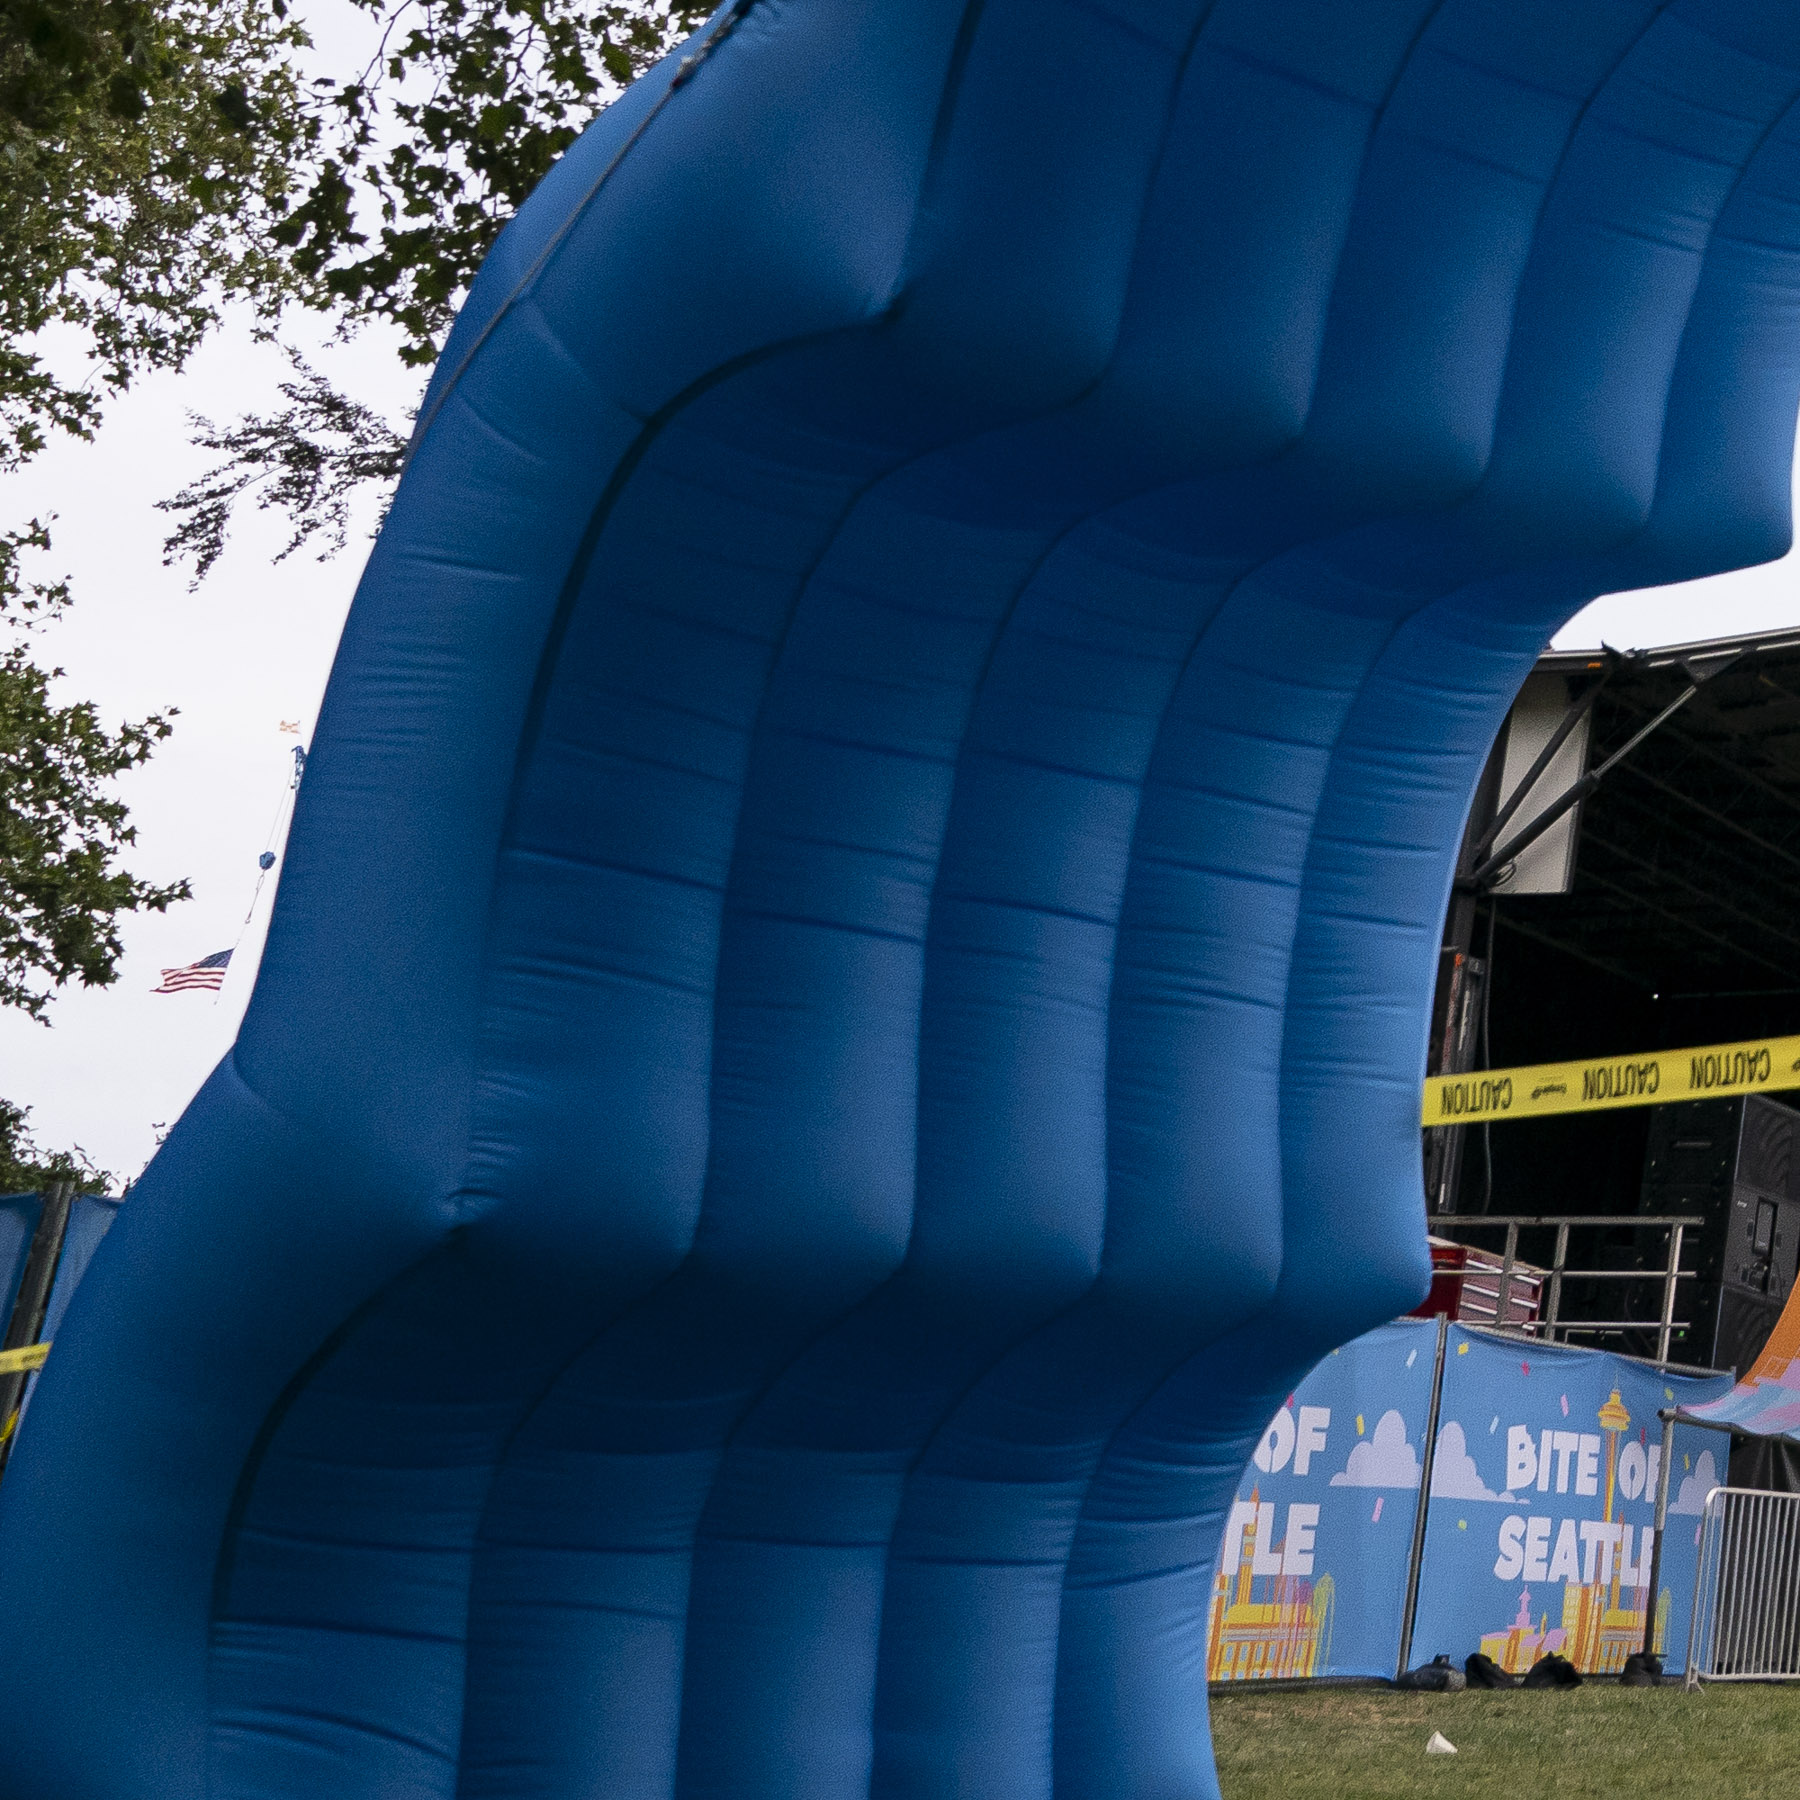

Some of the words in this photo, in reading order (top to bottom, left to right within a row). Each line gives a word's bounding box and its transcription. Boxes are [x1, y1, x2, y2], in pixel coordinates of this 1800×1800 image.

[1440, 1077, 1512, 1117] CAUTION
[1583, 1061, 1659, 1100] CAUTION
[1689, 1048, 1771, 1089] CAUTION
[1254, 1406, 1331, 1476] OF
[1507, 1424, 1600, 1496] BITE
[1618, 1441, 1662, 1503] OF
